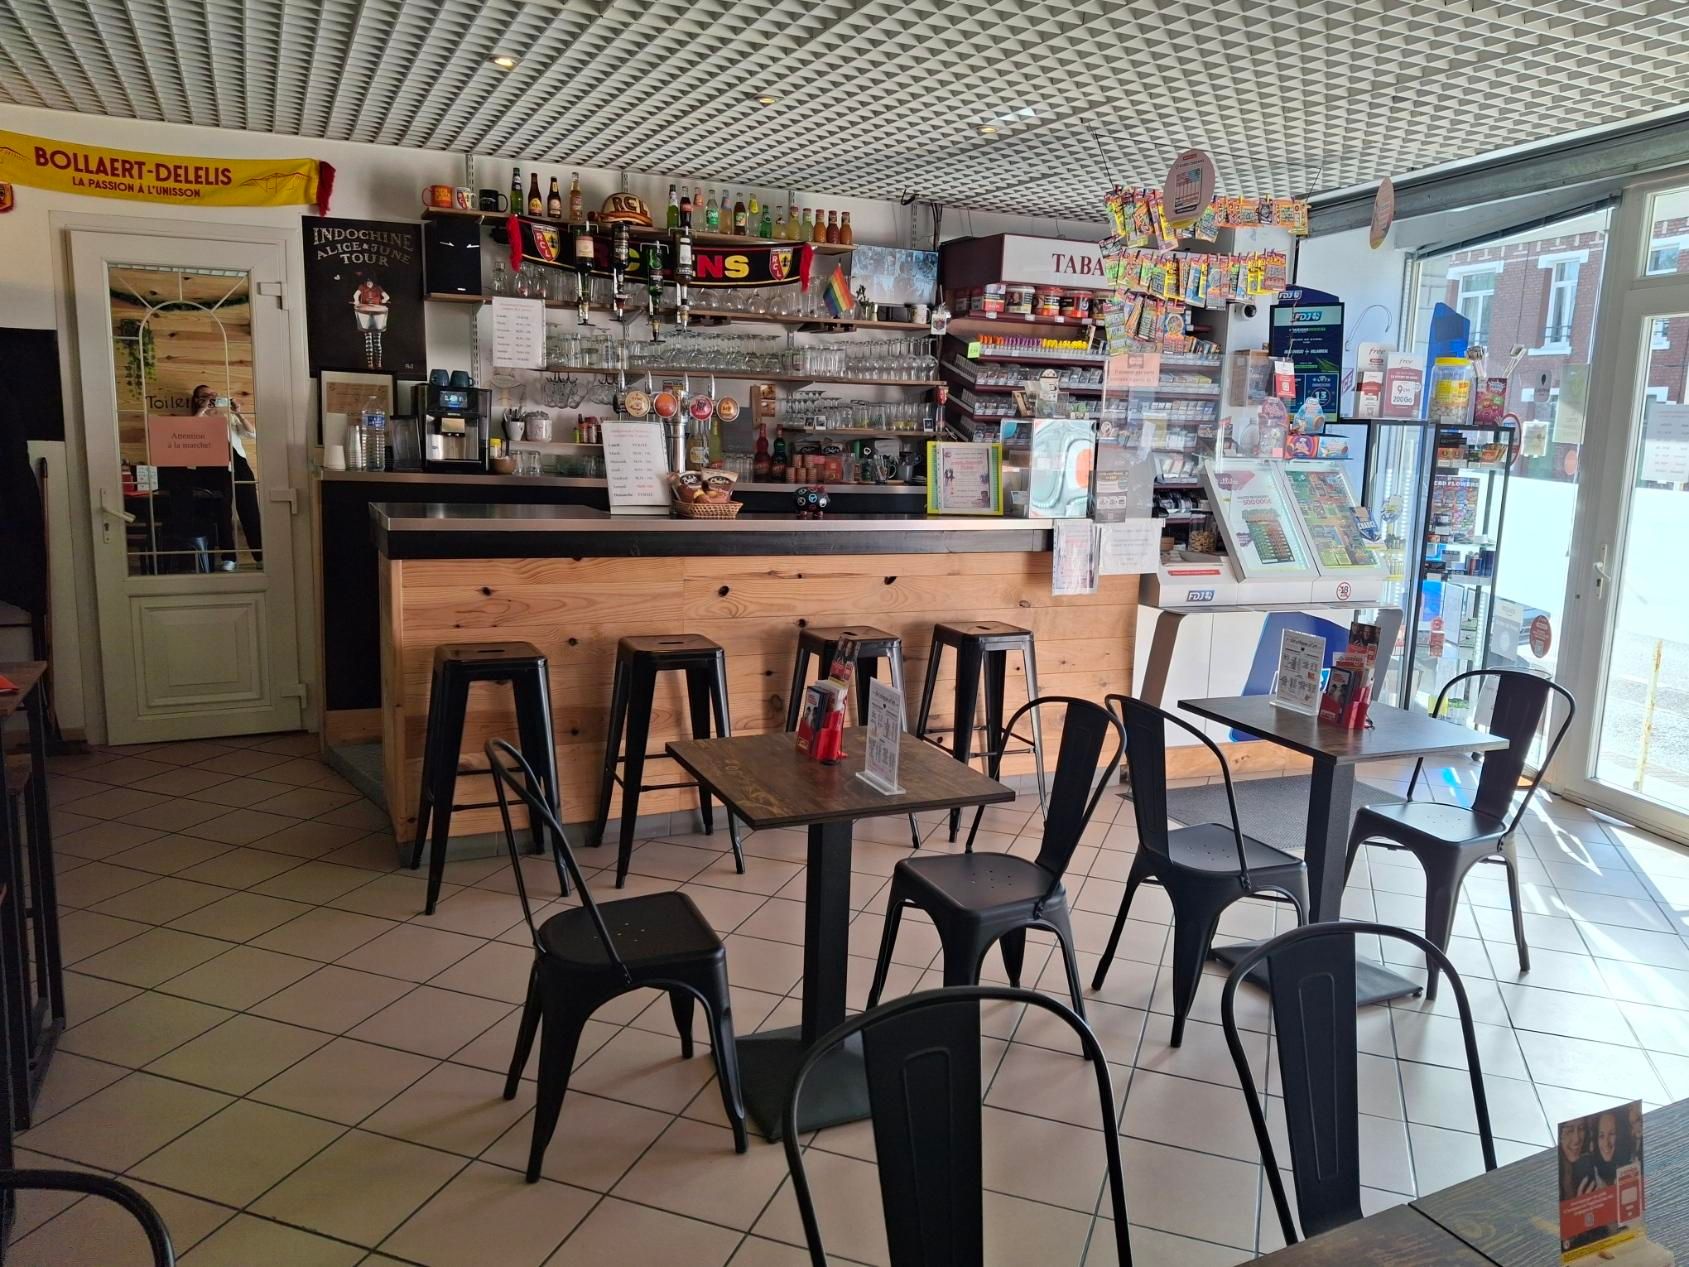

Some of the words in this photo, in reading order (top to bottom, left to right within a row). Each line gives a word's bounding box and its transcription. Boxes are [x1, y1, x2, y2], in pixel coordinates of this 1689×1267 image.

[34, 146, 233, 186] BOLLAERT-DELELIS
[72, 176, 85, 187] LA
[88, 179, 135, 193] PASSION
[138, 181, 145, 193] À
[148, 184, 202, 198] L'UNISSON
[313, 227, 414, 252] INDOCHINE
[317, 241, 361, 261] ALICE
[371, 244, 411, 265] JUNE
[340, 253, 389, 267] TOUR
[1052, 253, 1104, 277] TABA
[1295, 312, 1311, 321] FDJ
[146, 395, 216, 409] Toiletes
[171, 432, 206, 440] Attention
[1188, 592, 1205, 602] FDJ
